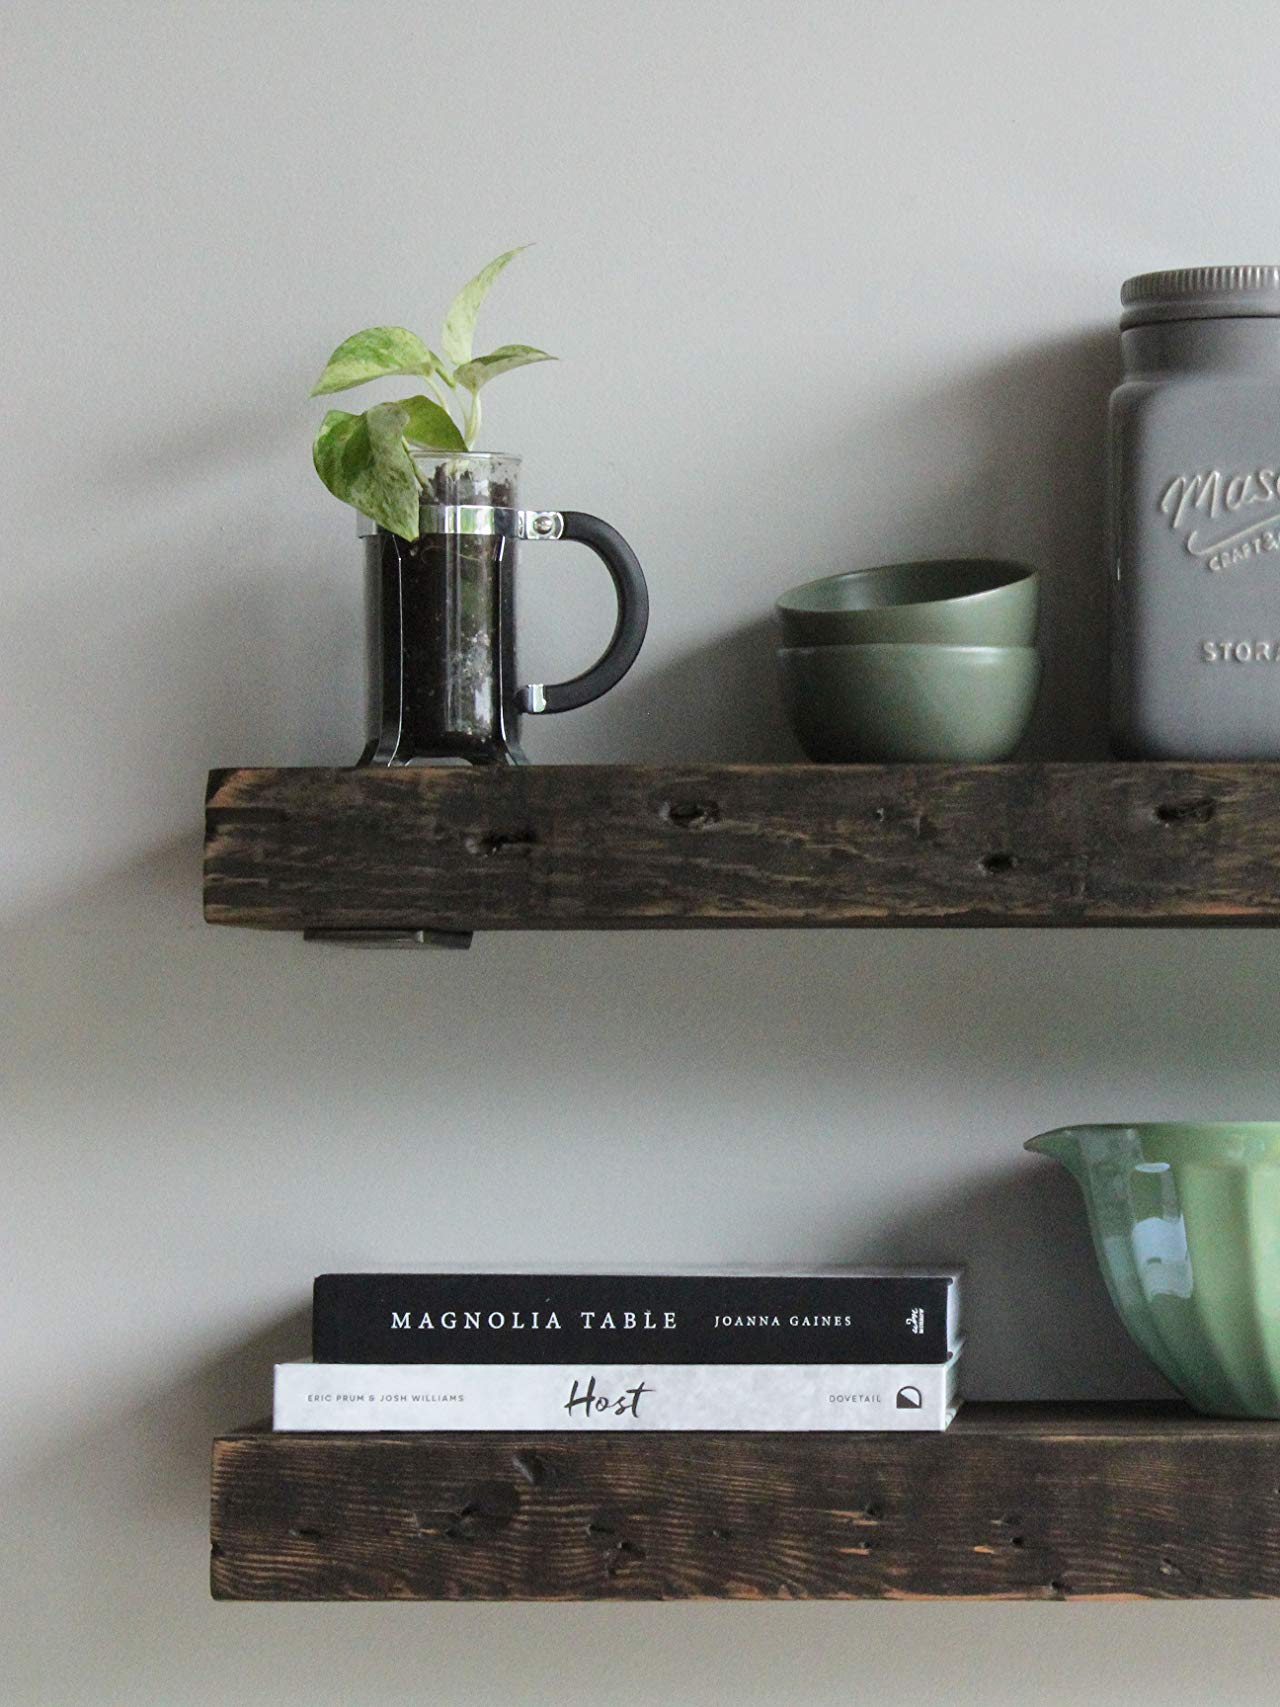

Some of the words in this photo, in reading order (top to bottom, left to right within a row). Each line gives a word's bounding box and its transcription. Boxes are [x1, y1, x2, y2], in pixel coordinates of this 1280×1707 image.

[1208, 537, 1261, 571] CRAFT
[391, 1311, 562, 1330] MAGNOLIA
[580, 1311, 677, 1330] TABLE
[714, 1315, 781, 1328] JOANNA
[789, 1315, 852, 1327] GAINES
[307, 1394, 332, 1402] ERIC
[336, 1394, 365, 1402] PRUM
[379, 1394, 407, 1402] JOSH
[411, 1394, 465, 1402] WILLIAMS
[563, 1375, 656, 1418] Host
[829, 1394, 881, 1403] DOVETAIL
